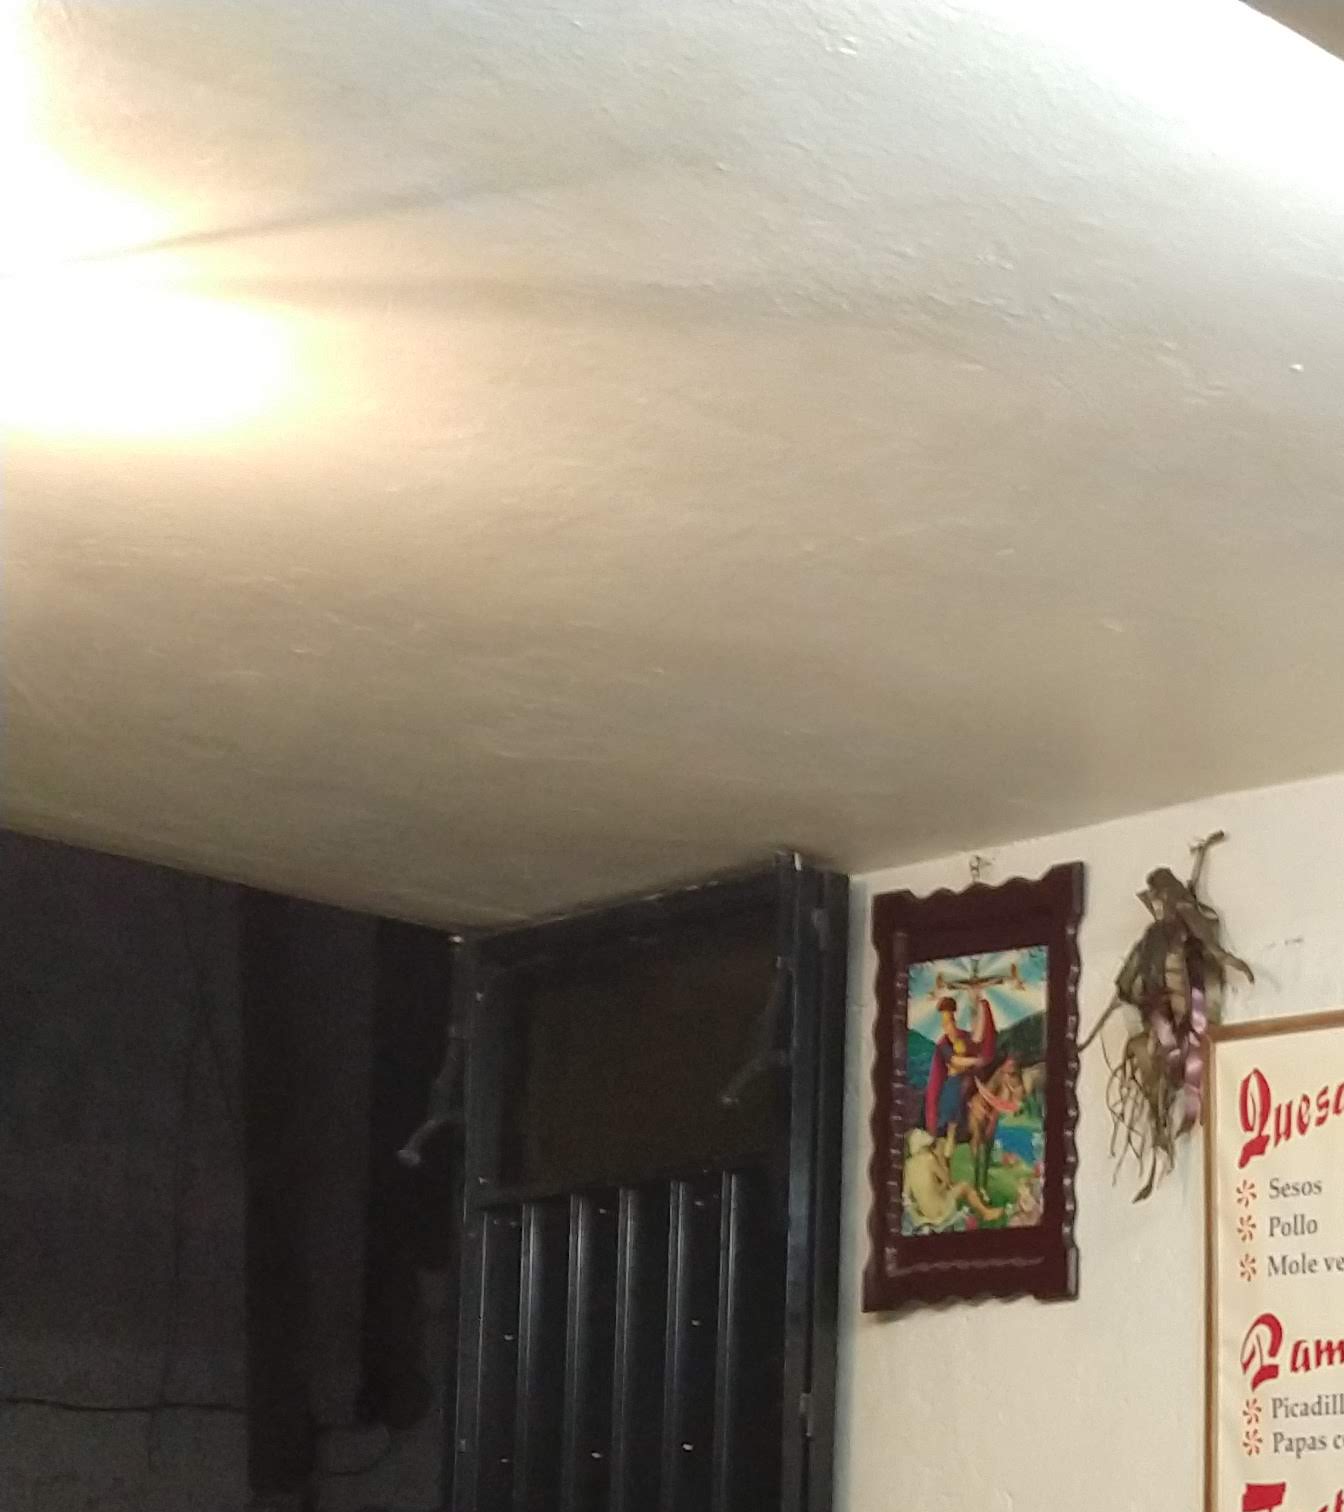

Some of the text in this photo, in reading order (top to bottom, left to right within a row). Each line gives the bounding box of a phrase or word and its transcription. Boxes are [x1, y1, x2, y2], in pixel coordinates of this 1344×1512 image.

[1268, 1177, 1323, 1200] Sesos
[1269, 1213, 1318, 1238] Pollo
[1267, 1253, 1317, 1277] Mole
[1273, 1430, 1327, 1458] Papas
